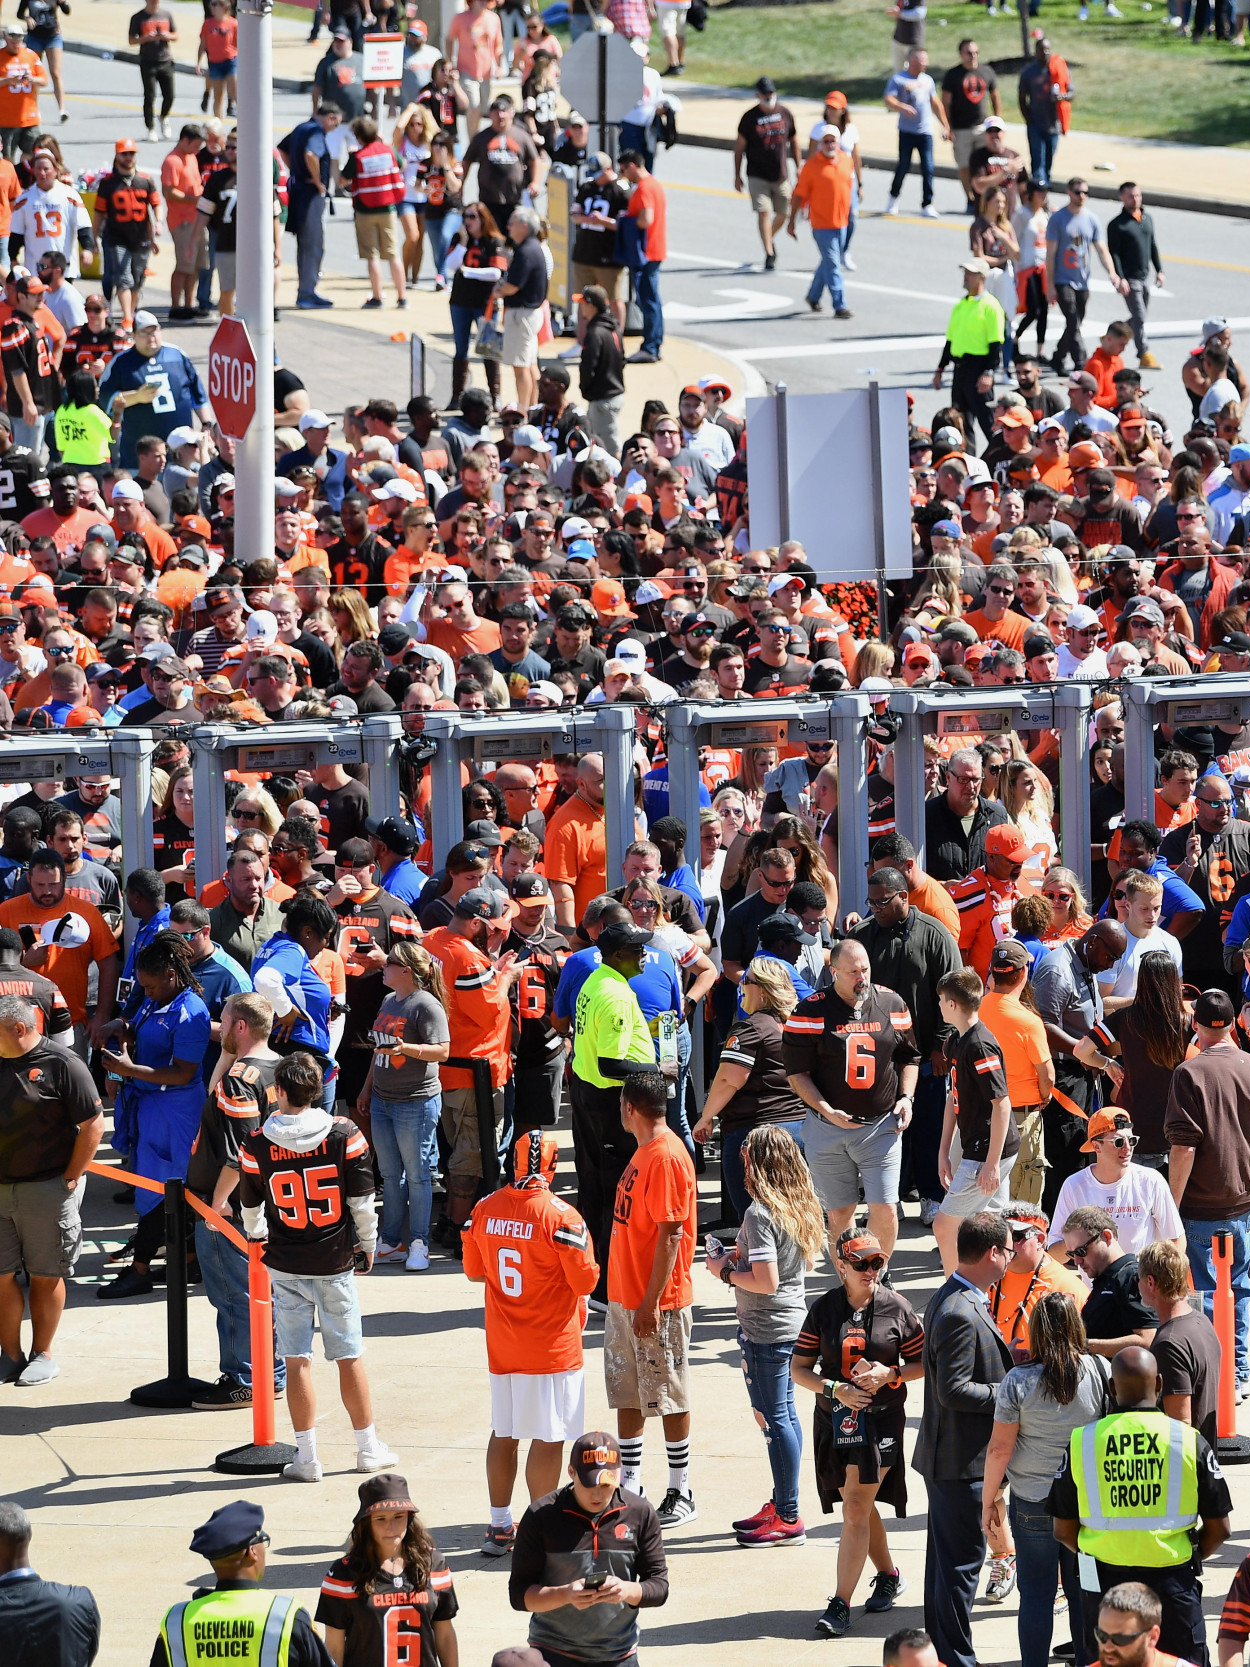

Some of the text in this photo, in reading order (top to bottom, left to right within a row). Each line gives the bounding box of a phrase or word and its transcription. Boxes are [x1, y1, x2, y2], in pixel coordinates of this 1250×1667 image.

[112, 189, 148, 222] 95
[35, 210, 63, 238] 13
[210, 353, 255, 405] STOP
[329, 745, 339, 753] 22
[1209, 858, 1236, 903] 6
[519, 965, 547, 1019] 6
[836, 1021, 883, 1038] CLEVELAND
[228, 1061, 261, 1085] 20
[844, 1032, 877, 1090] 6
[268, 1164, 343, 1230] 95
[486, 1216, 536, 1241] MAYFIELD
[497, 1247, 523, 1298] 6
[837, 1433, 864, 1446] INDIANS
[1104, 1432, 1162, 1457] APEX
[1103, 1458, 1165, 1483] SECURITY
[1110, 1484, 1163, 1509] GROUP
[373, 1590, 430, 1607] CLEVELAND
[194, 1619, 256, 1641] CLEVELAND
[383, 1604, 422, 1667] 6
[195, 1639, 251, 1660] POLICE
